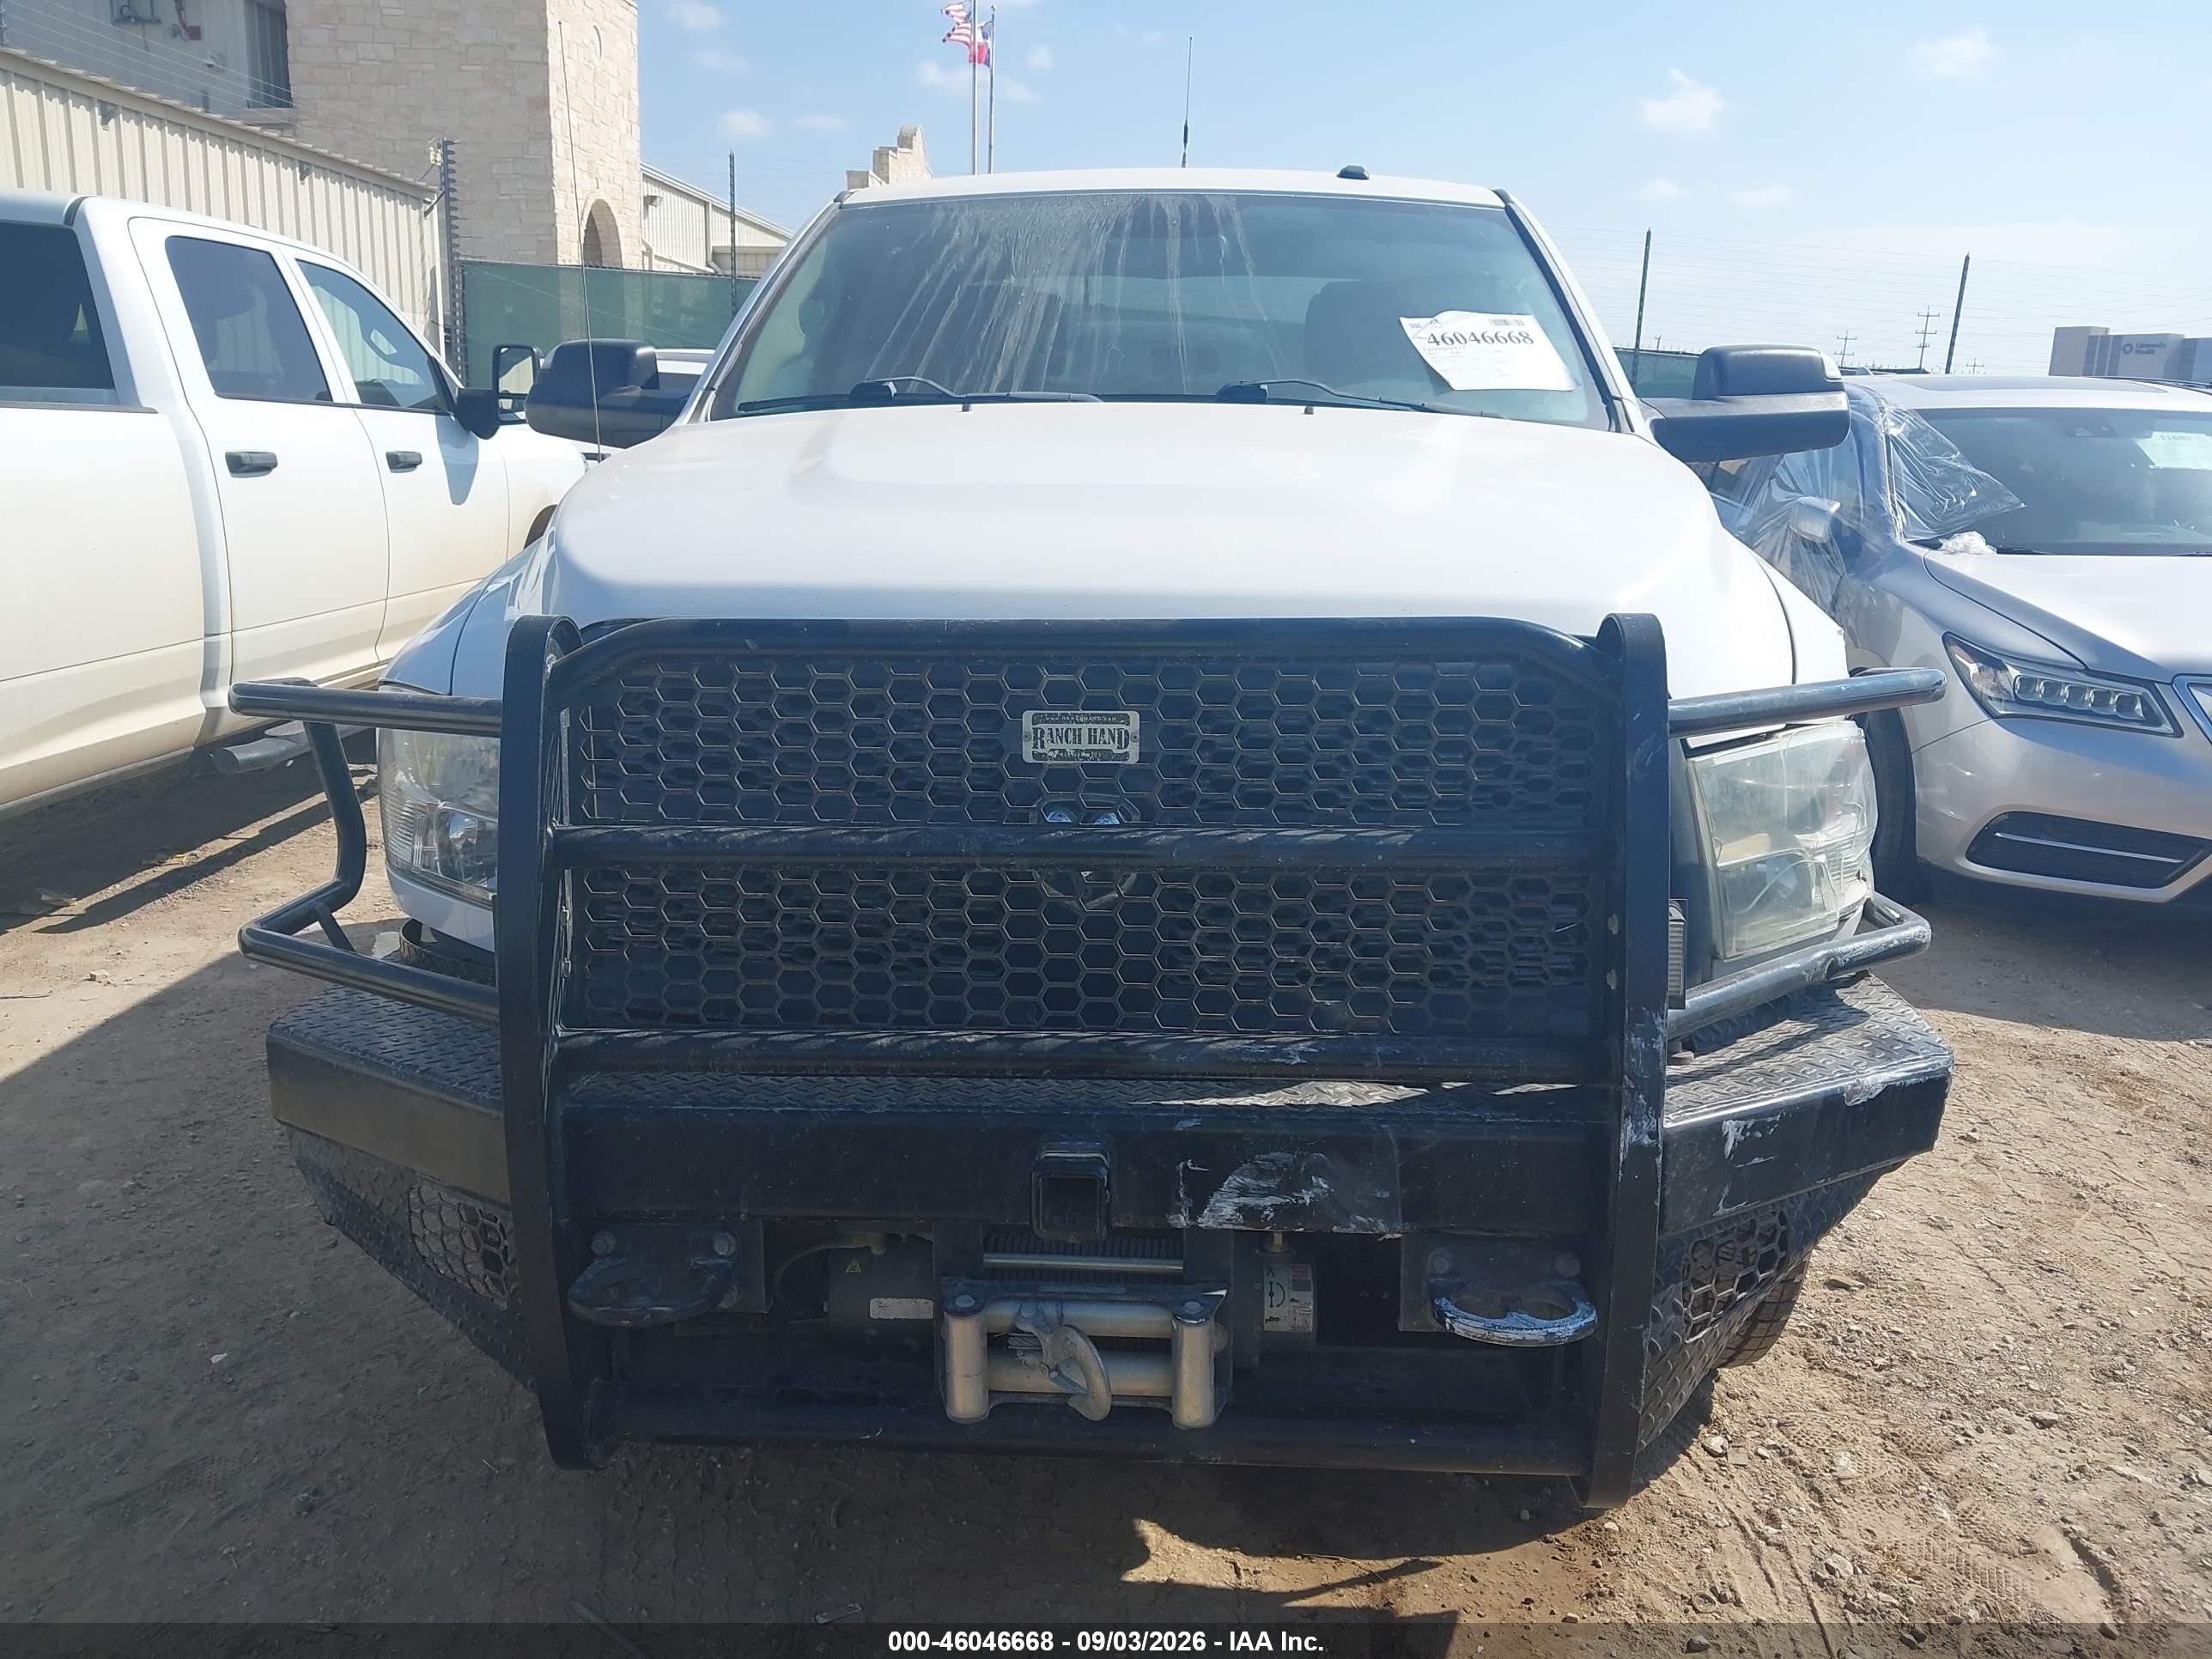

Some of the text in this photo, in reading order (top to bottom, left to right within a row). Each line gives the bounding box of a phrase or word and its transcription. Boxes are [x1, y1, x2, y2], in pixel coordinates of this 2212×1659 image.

[1427, 331, 1534, 346] 46046668
[1032, 726, 1130, 750] RANCH HAND
